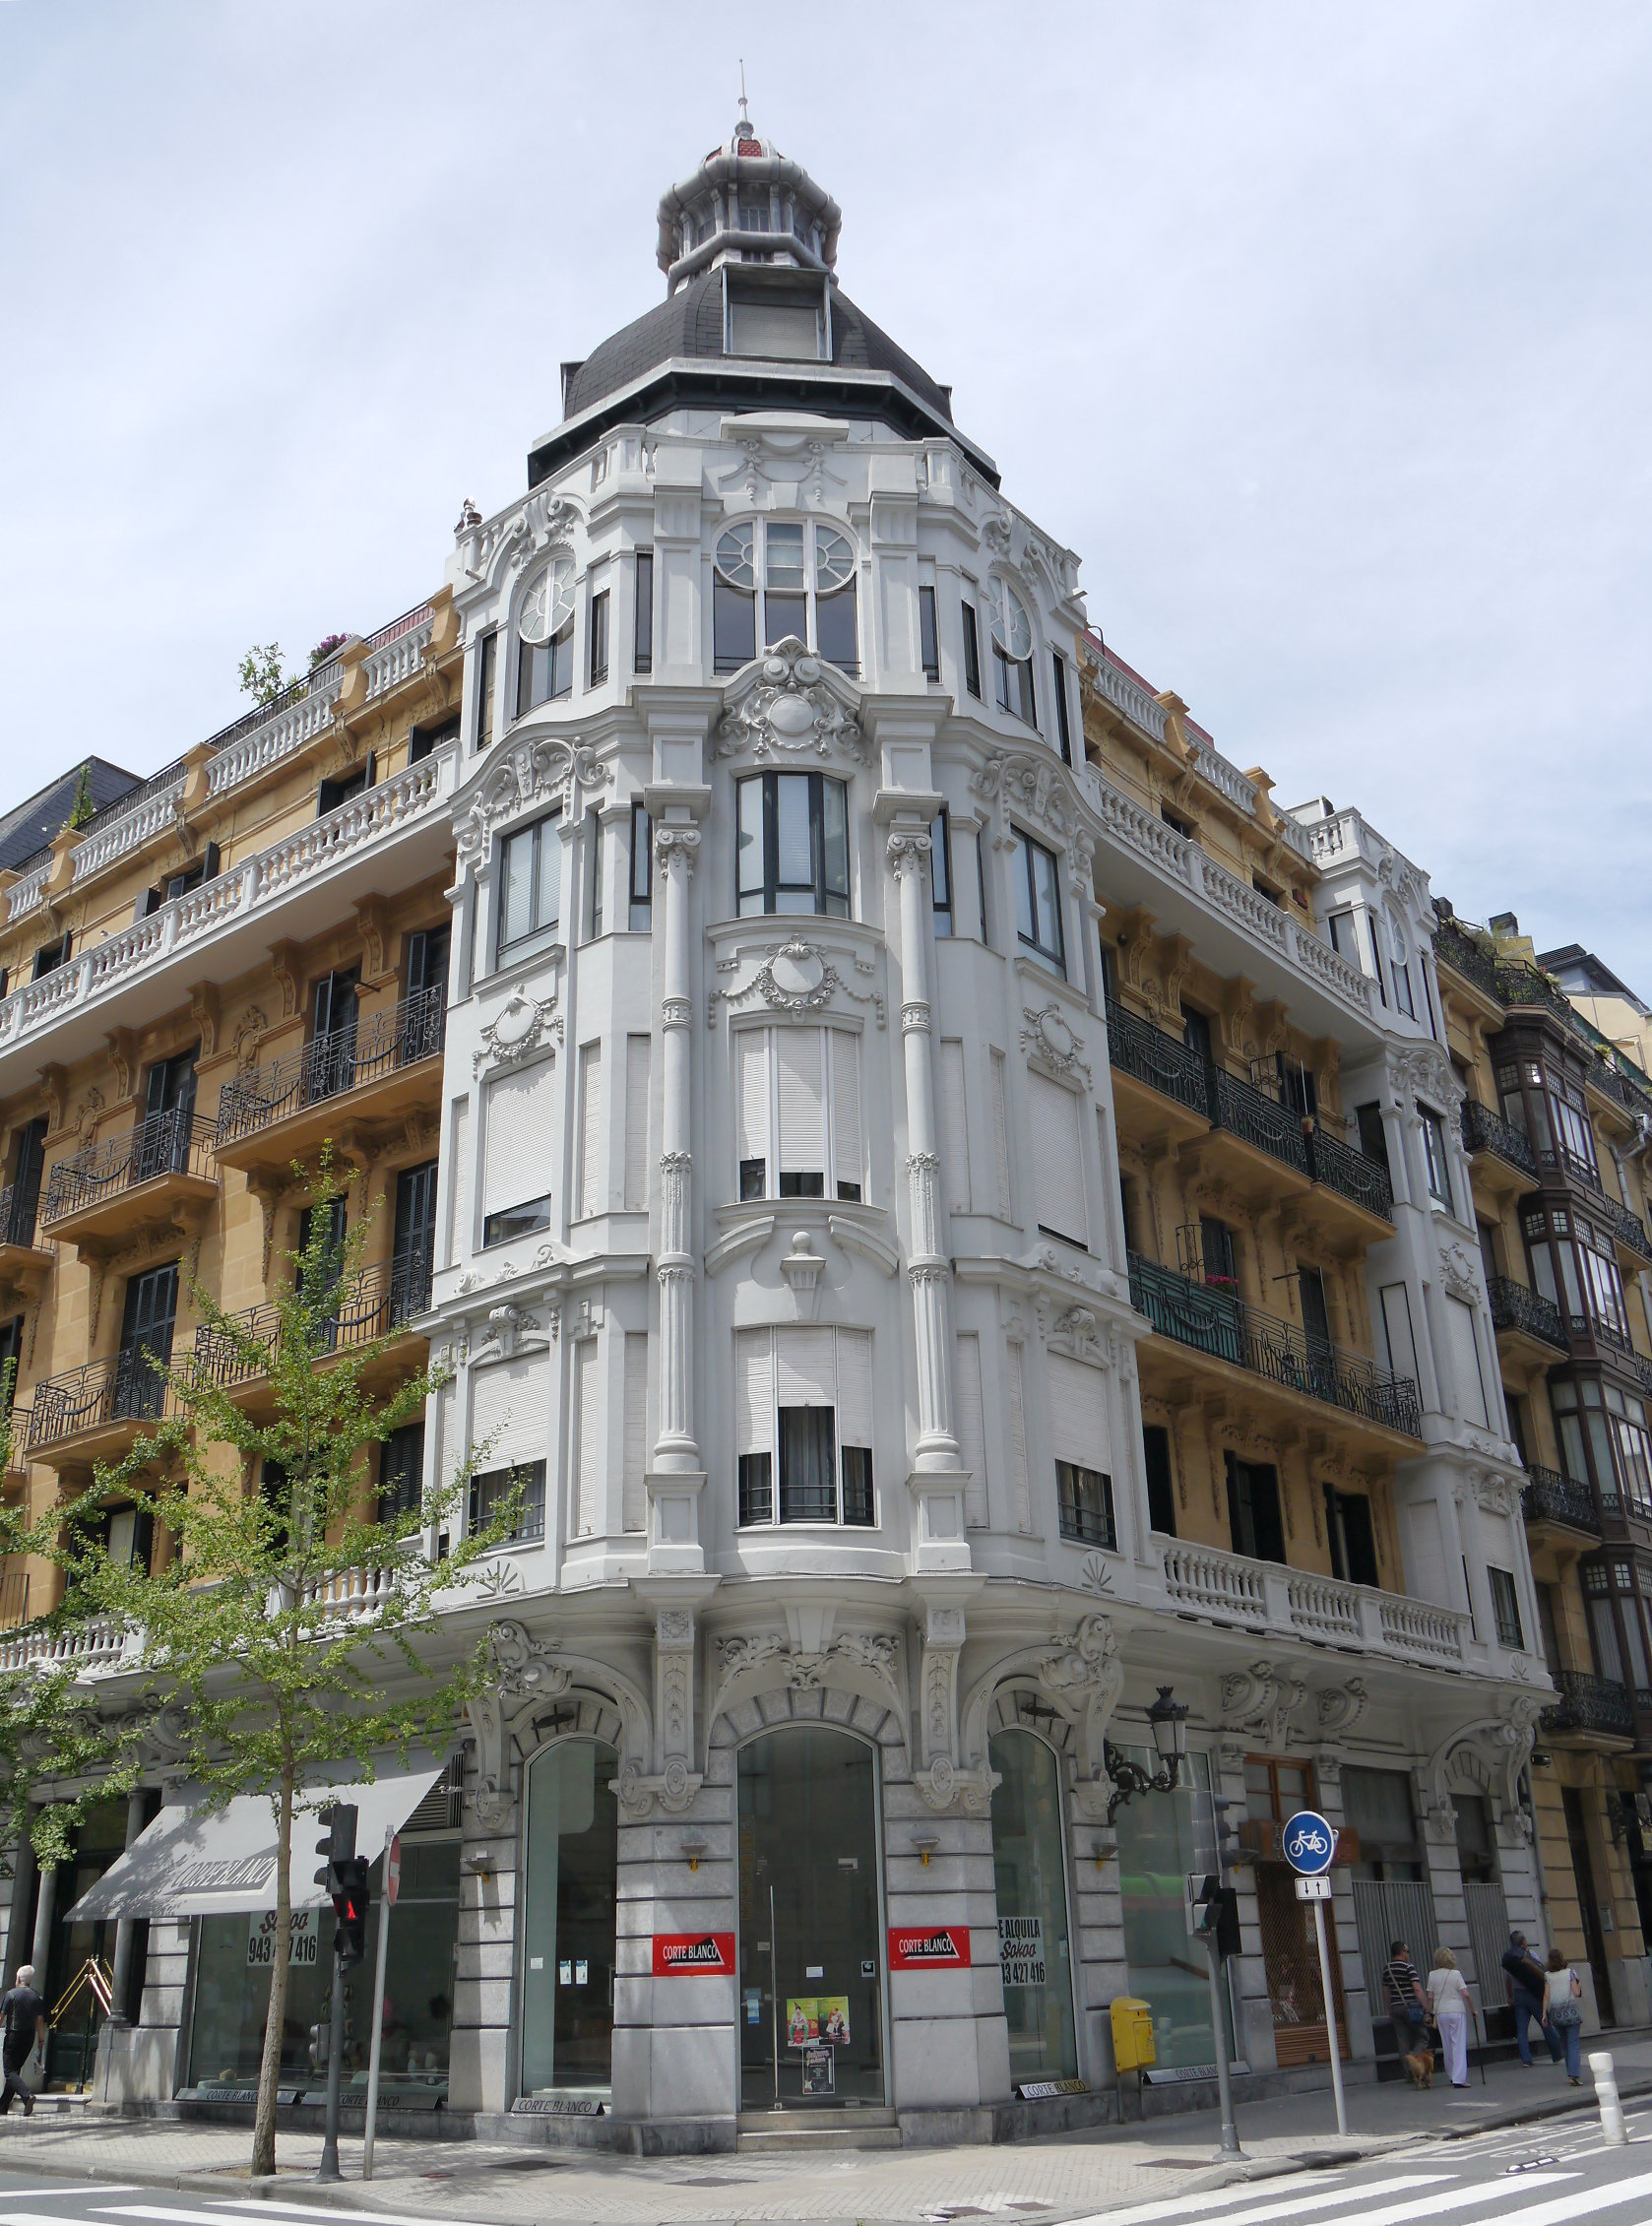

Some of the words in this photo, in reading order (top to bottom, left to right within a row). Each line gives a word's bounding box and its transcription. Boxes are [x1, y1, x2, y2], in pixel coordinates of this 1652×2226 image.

[171, 1862, 228, 1887] CORTE
[211, 1857, 278, 1886] BLANCO
[998, 1919, 1004, 1939] E
[1005, 1919, 1041, 1940] ALQUILA
[248, 1937, 271, 1962] 943
[295, 1935, 316, 1962] 416
[663, 1944, 687, 1960] CORTE
[688, 1943, 719, 1959] BLANCO
[899, 1939, 922, 1953] CORTE
[923, 1938, 952, 1952] BLANCO
[999, 1940, 1037, 1960] Sokoa
[1013, 1962, 1029, 1984] 427
[1030, 1961, 1046, 1983] 416
[207, 2090, 232, 2100] CORTE
[232, 2091, 259, 2102] BLANC
[1027, 2083, 1054, 2096] CORTE
[1054, 2080, 1086, 2093] BLANCO
[519, 2099, 551, 2111] CORTE
[552, 2101, 593, 2113] BLANCO
